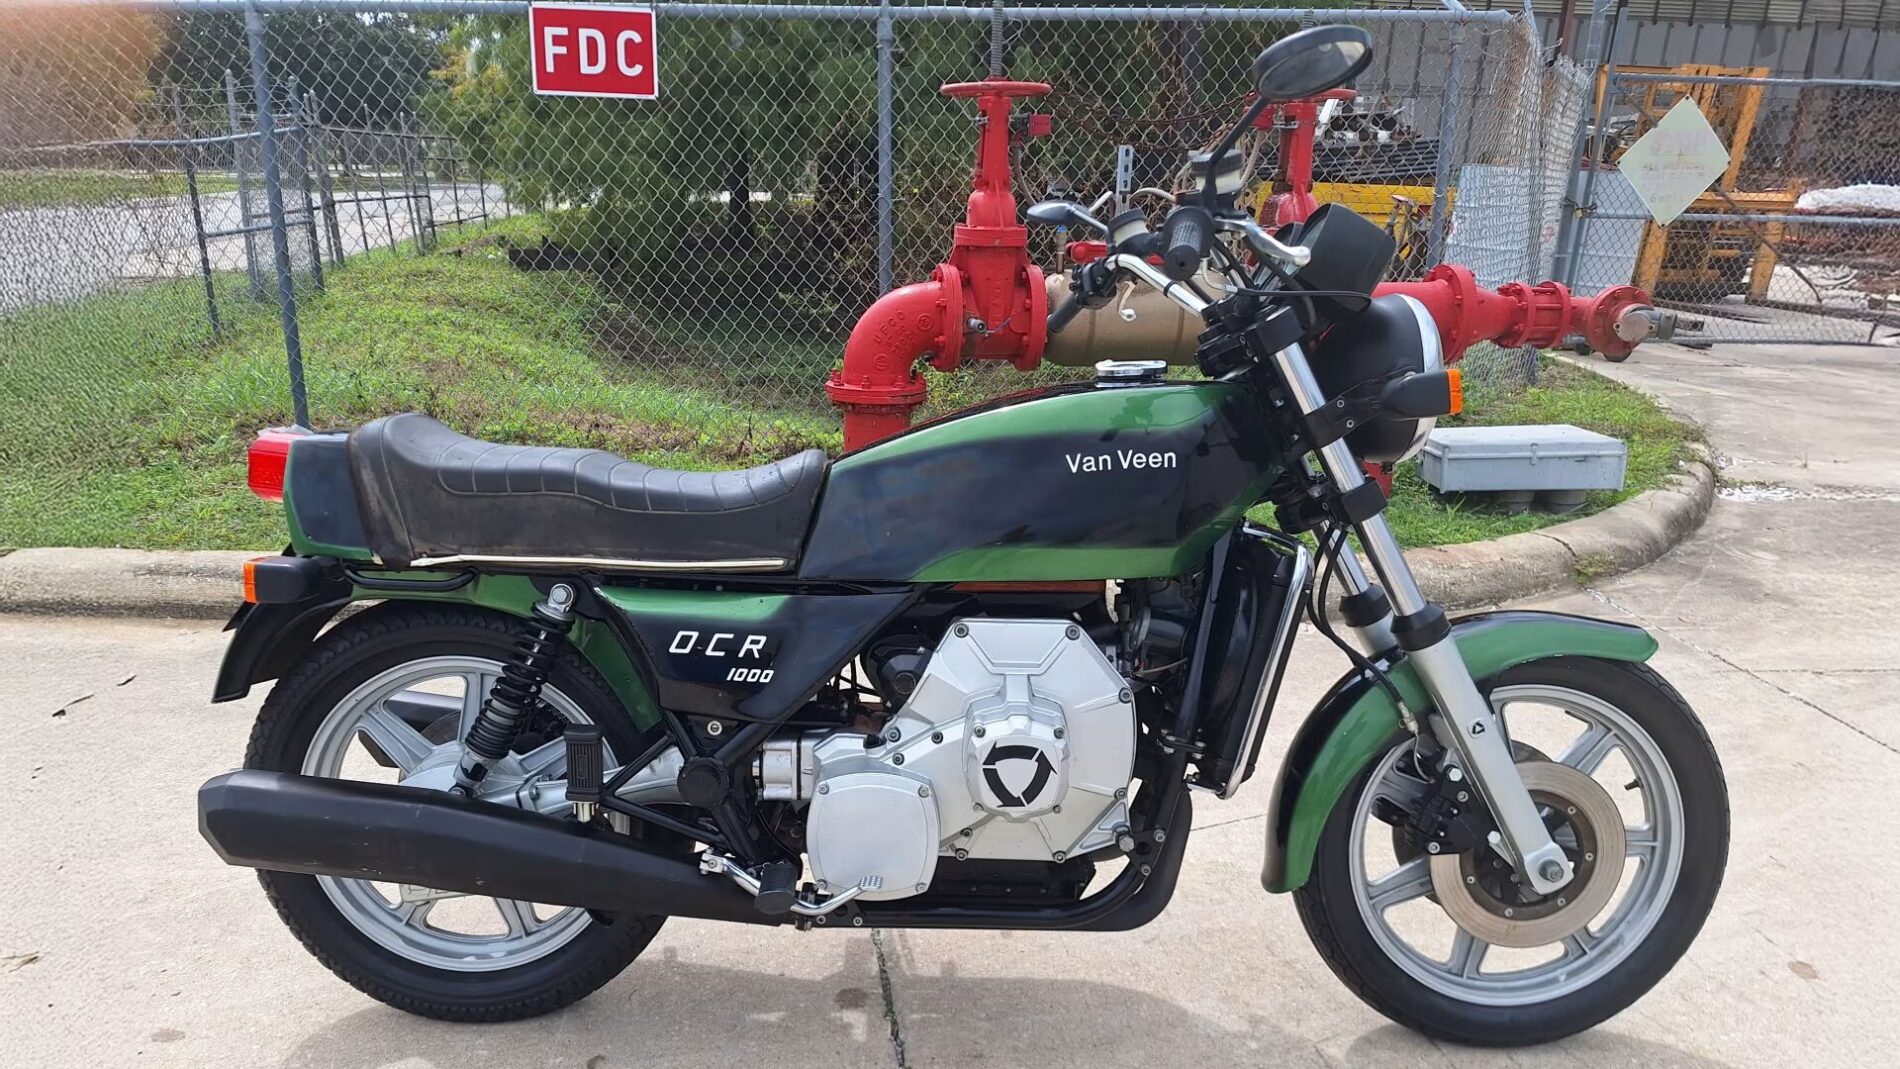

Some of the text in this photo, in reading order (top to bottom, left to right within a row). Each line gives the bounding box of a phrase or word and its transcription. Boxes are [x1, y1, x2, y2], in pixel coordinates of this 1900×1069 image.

[543, 26, 644, 77] FDC
[1065, 449, 1177, 473] Van Veen
[726, 667, 775, 683] 1000
